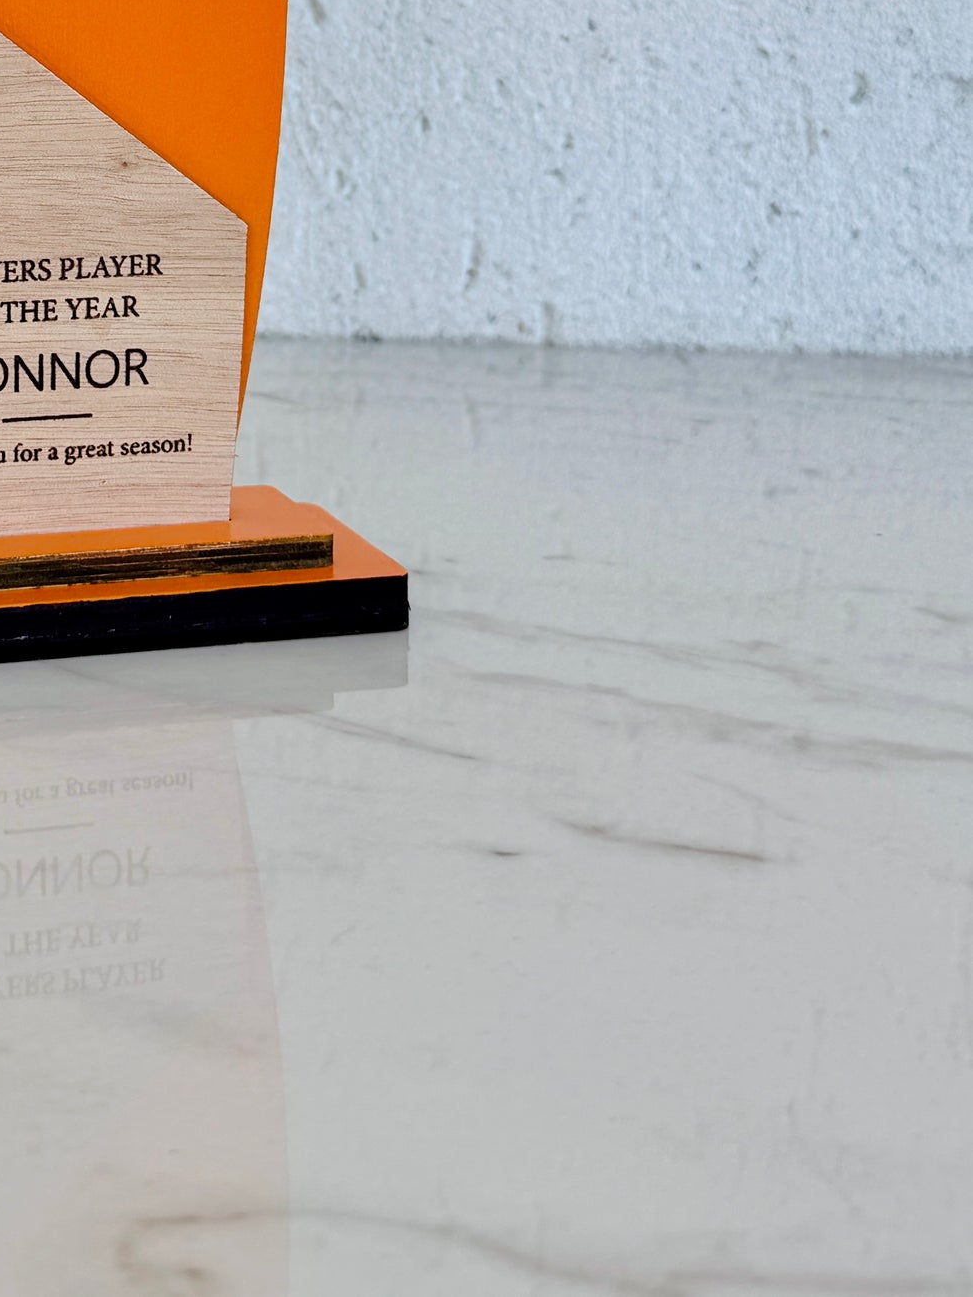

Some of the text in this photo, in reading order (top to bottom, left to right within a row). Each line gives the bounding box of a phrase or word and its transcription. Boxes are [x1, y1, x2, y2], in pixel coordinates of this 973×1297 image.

[58, 253, 164, 281] PLAYER
[0, 299, 59, 324] THE
[64, 295, 140, 321] YEAR
[12, 442, 43, 463] for
[47, 446, 60, 461] a
[64, 440, 115, 466] great
[120, 433, 193, 457] season!
